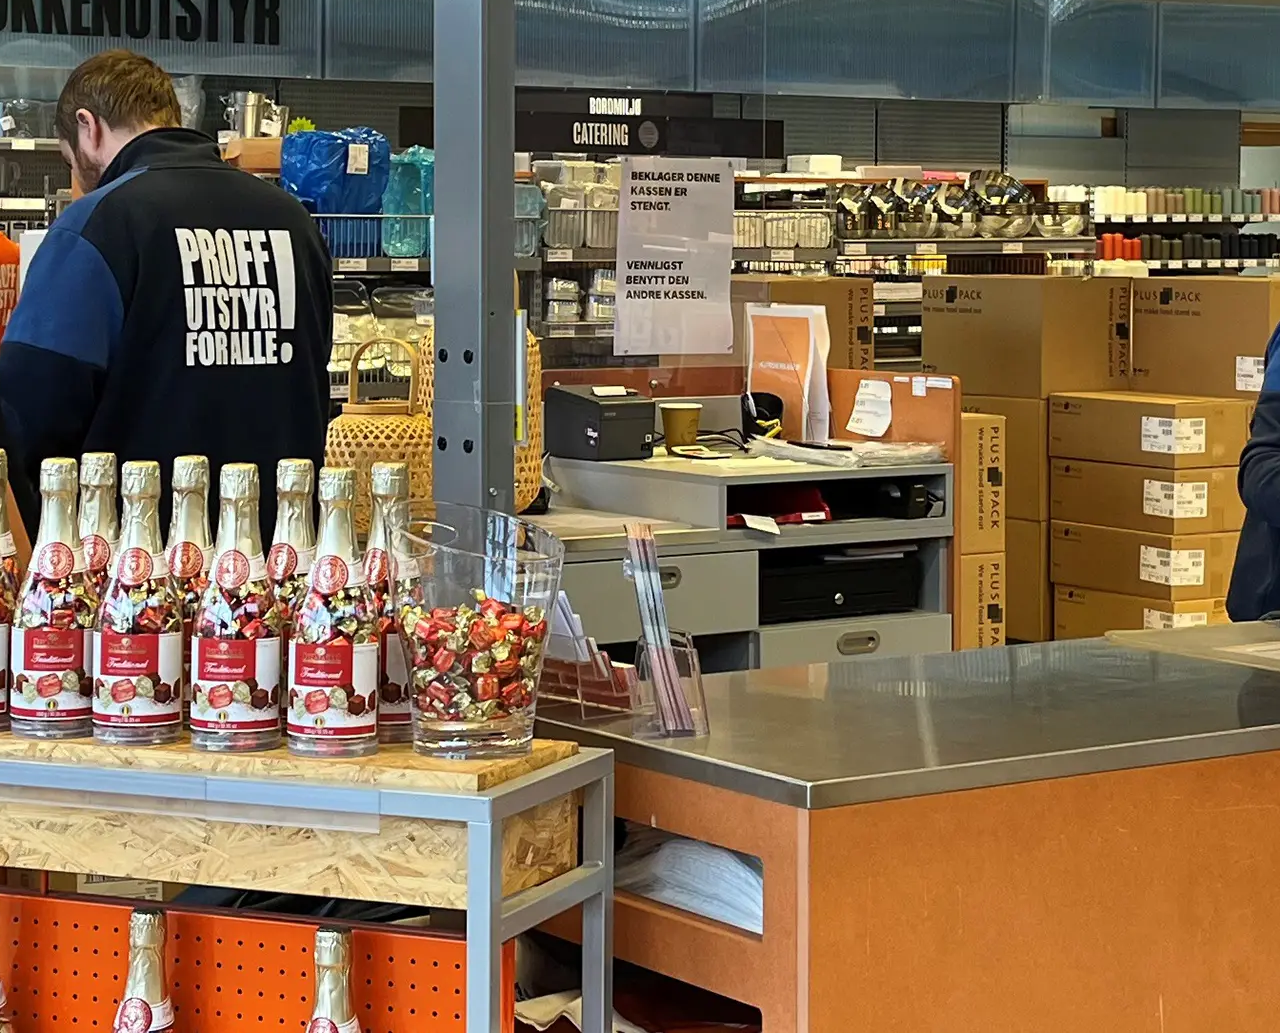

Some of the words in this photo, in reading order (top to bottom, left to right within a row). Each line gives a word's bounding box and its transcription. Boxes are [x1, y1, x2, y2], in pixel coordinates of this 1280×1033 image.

[589, 97, 641, 116] BORDMILJØ
[573, 122, 629, 146] CATERING
[631, 171, 684, 182] BEKLAGER
[686, 172, 720, 183] DENNE
[631, 186, 671, 197] KASSEN
[674, 187, 688, 197] ER
[631, 200, 671, 211] STENGT.
[175, 228, 270, 285] PROFF
[627, 260, 683, 271] VENNLIGST
[625, 275, 665, 286] BENYTT
[668, 275, 689, 285] DEN
[625, 289, 661, 300] ANDRE
[663, 289, 707, 300] KASSEN.
[923, 289, 944, 299] PLUS
[959, 289, 982, 300] PACK
[1133, 290, 1157, 300] PLUS
[1175, 291, 1201, 302] PACK
[185, 288, 276, 331] UTSTYR
[860, 287, 868, 323] PLUS
[990, 426, 999, 463] PLUS
[991, 491, 999, 528] PACK
[990, 563, 999, 600] PLUS
